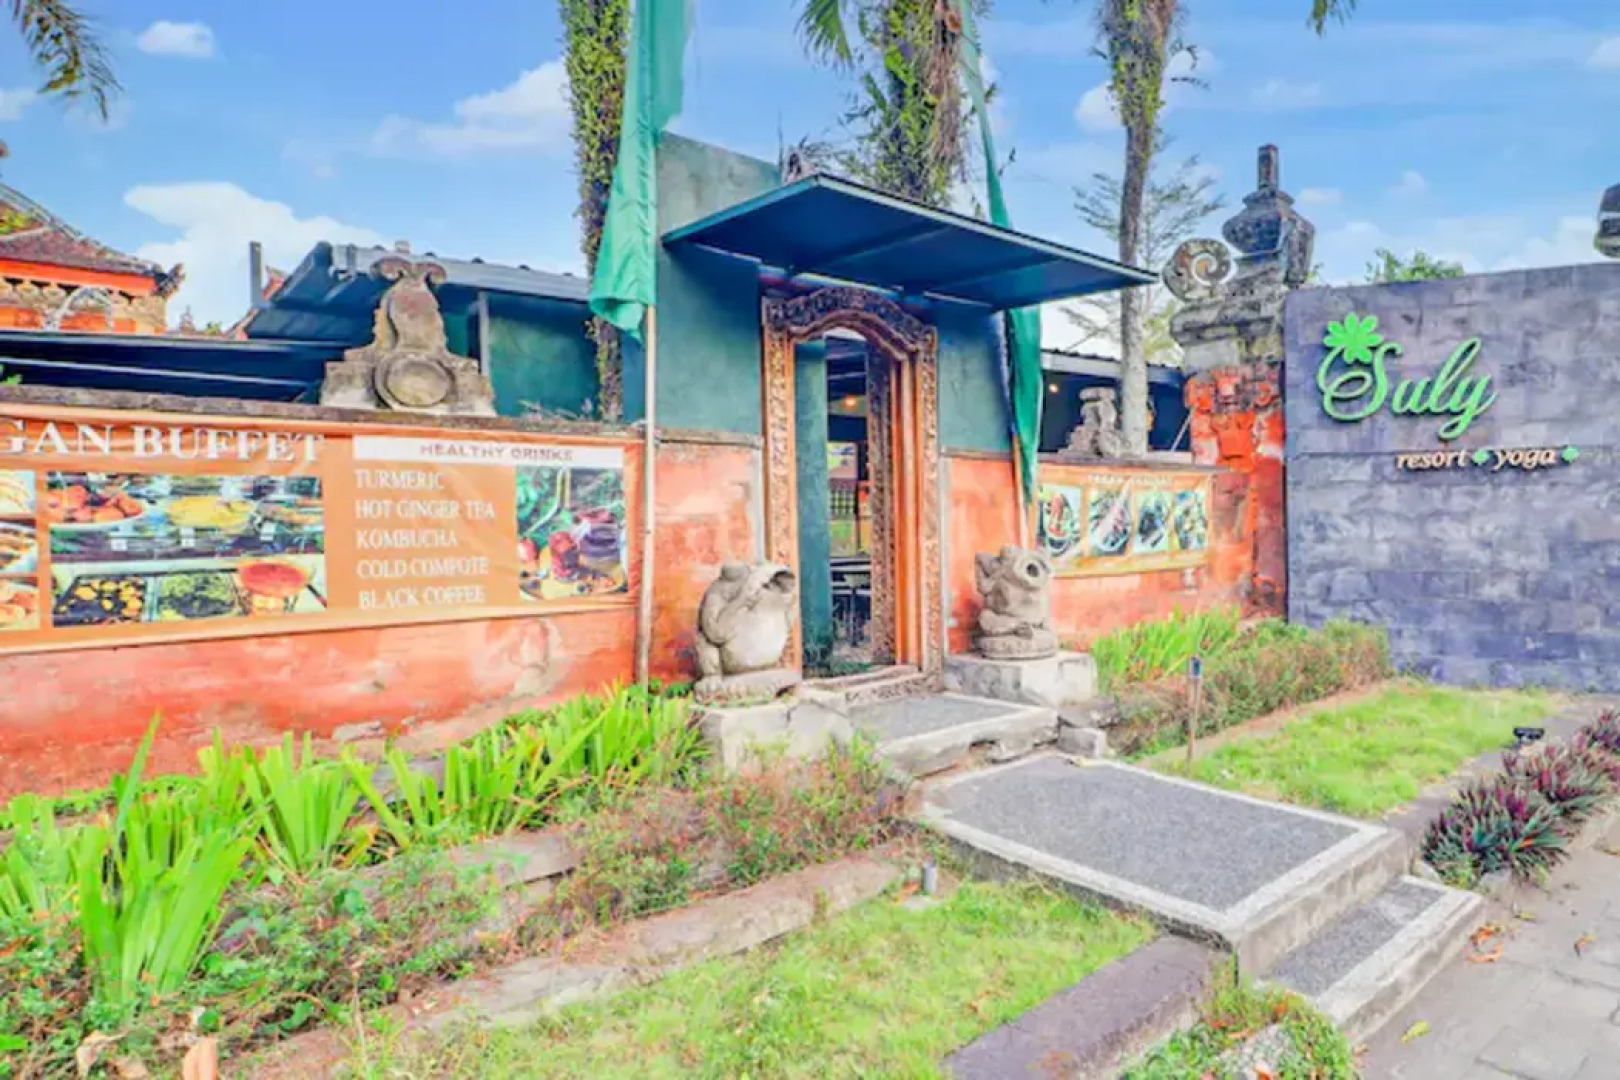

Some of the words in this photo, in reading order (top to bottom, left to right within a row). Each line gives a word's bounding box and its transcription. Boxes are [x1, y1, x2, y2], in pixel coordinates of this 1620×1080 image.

[1316, 337, 1498, 439] Suly
[130, 425, 325, 462] BUFFET
[420, 443, 504, 458] HEALTHY
[511, 447, 573, 461] DRINKS
[1396, 450, 1467, 469] resort
[1493, 447, 1556, 470] yoga
[354, 469, 445, 490] TURMERIC
[355, 500, 391, 519] HOT
[397, 500, 459, 519] GINGER
[465, 500, 496, 519] TEA
[357, 529, 458, 549] KOMBUCHA
[357, 559, 406, 579] COLD
[410, 556, 489, 577] COMPOTE
[359, 588, 418, 609] BLACK
[423, 584, 486, 604] COFFEE
